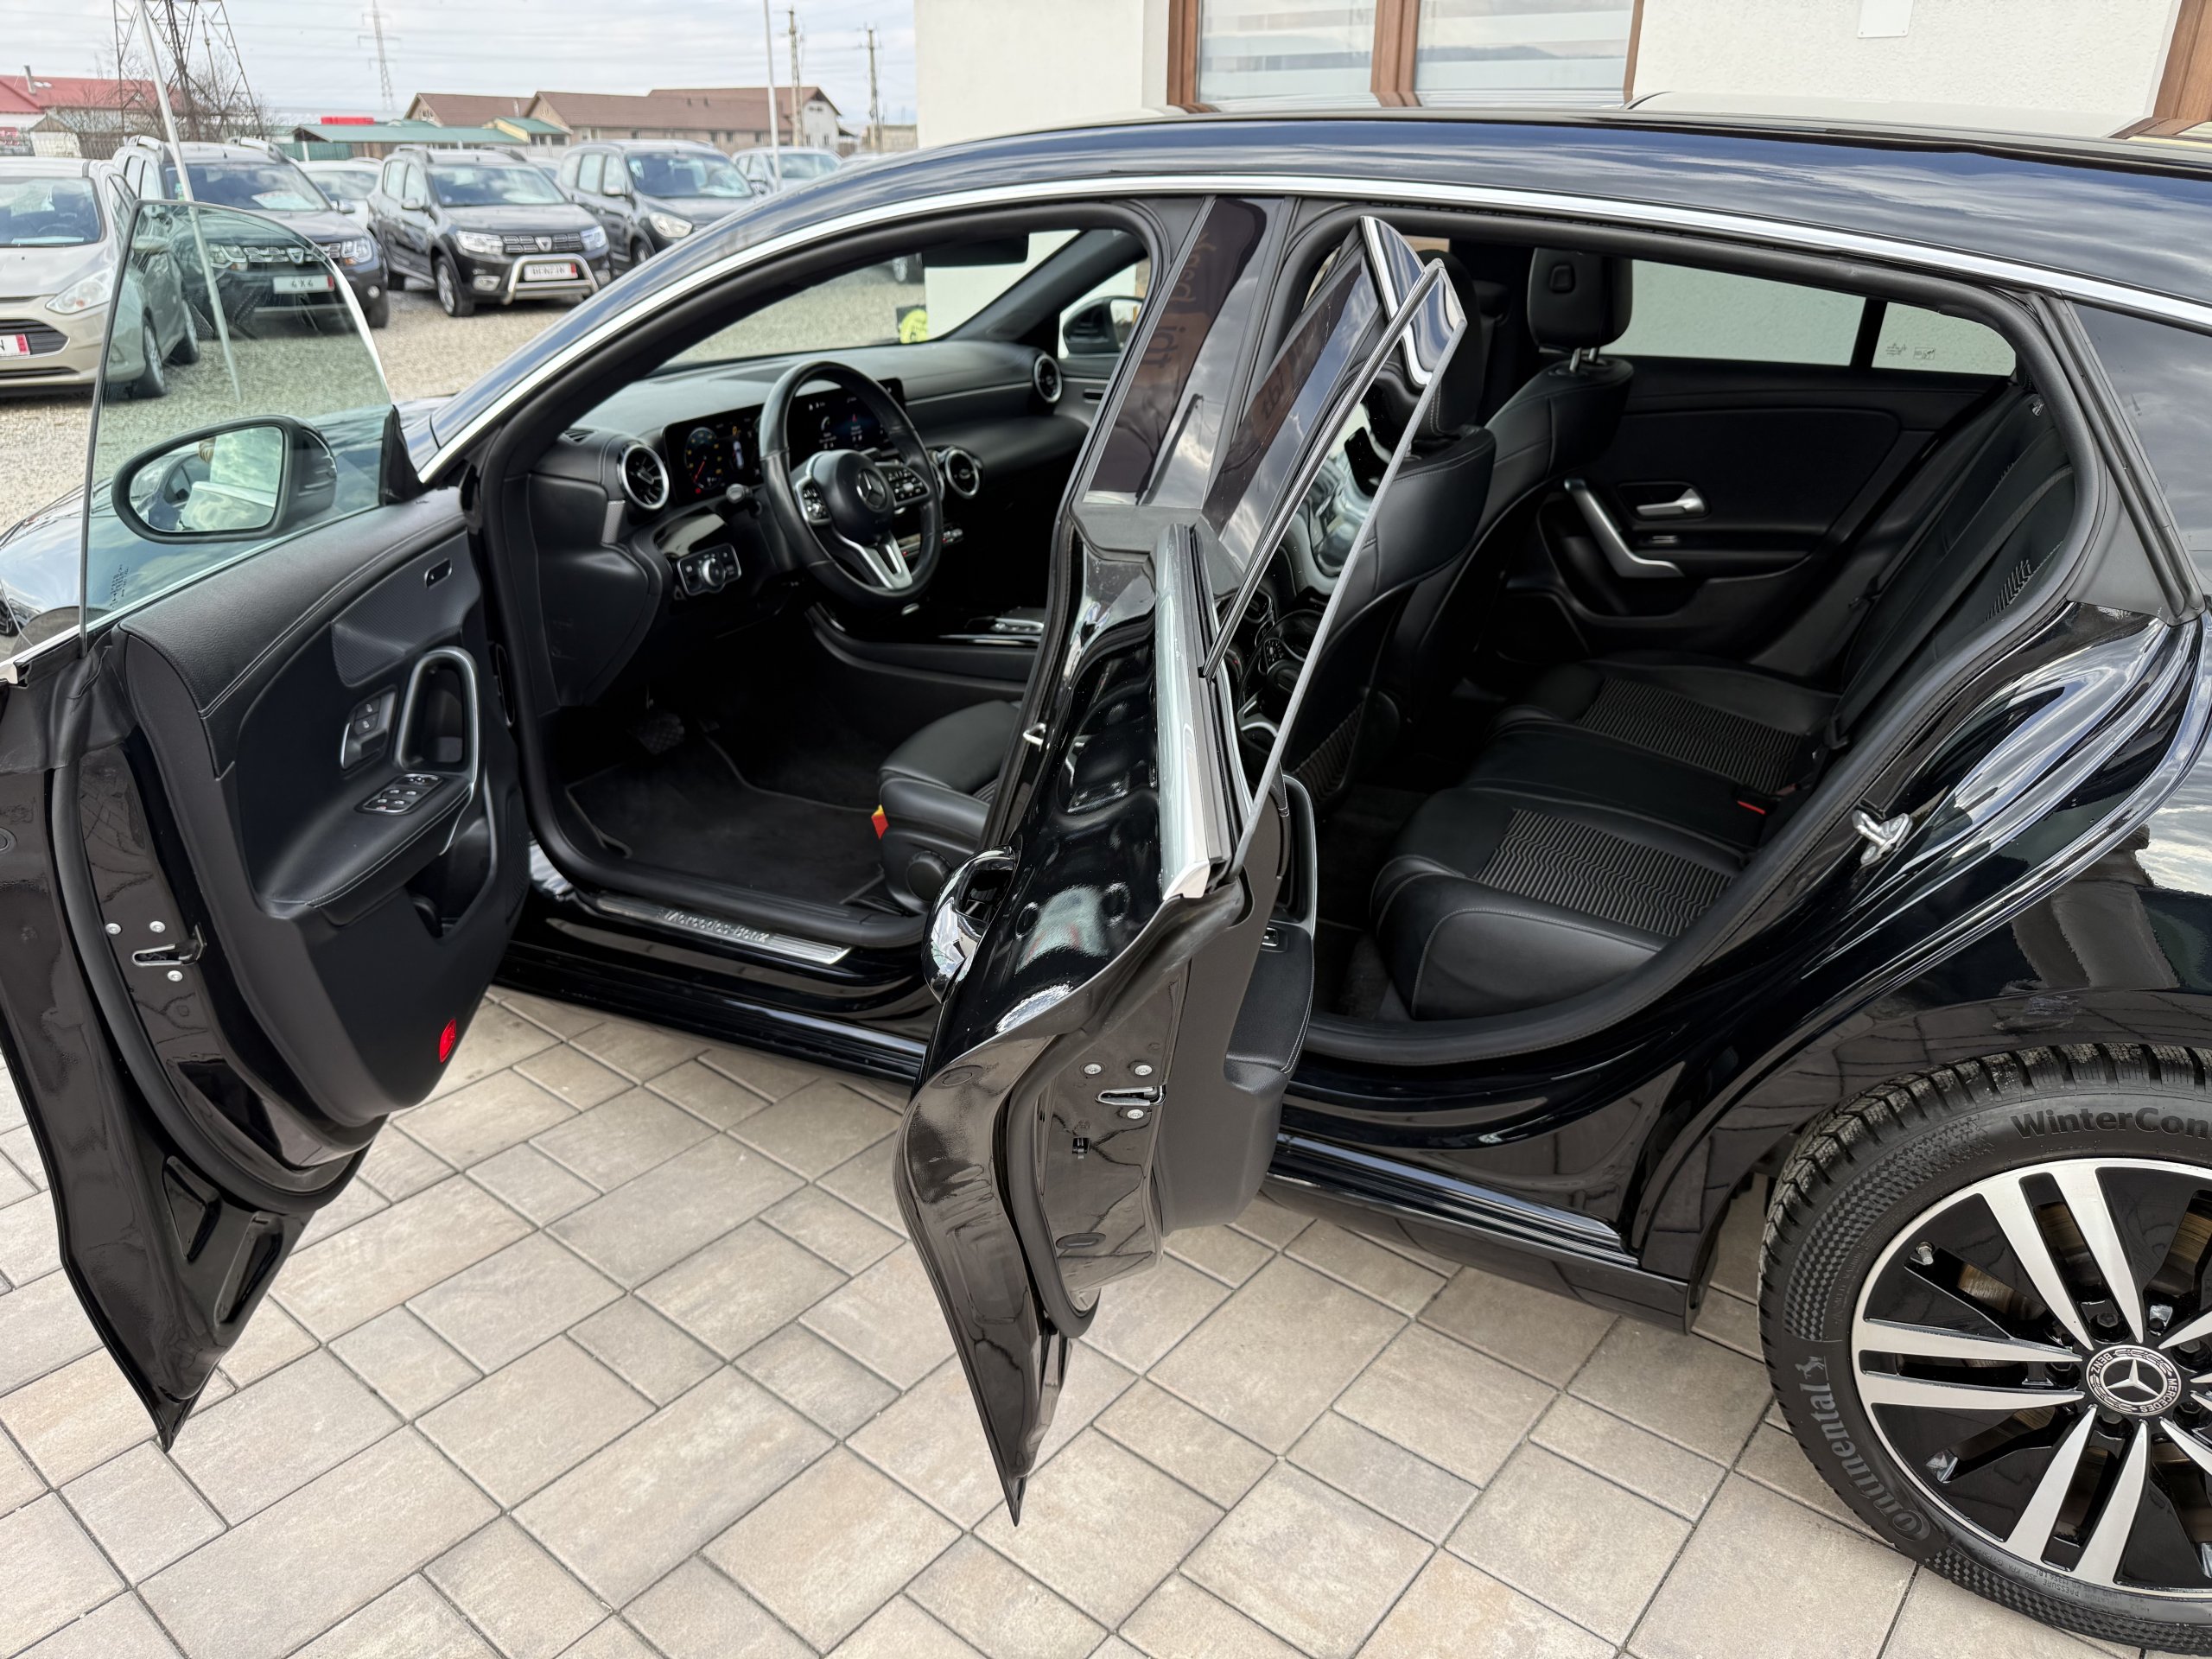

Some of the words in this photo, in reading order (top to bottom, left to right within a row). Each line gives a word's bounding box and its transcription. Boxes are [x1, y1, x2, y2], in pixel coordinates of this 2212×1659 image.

[2010, 1107, 2212, 1140] WinterCon
[2090, 1353, 2113, 1375] BENZ
[2139, 1377, 2179, 1414] MERCEDES
[1800, 1382, 1931, 1541] Continental
[2024, 1572, 2037, 1582] 350
[2043, 1579, 2080, 1597] PRESSURE
